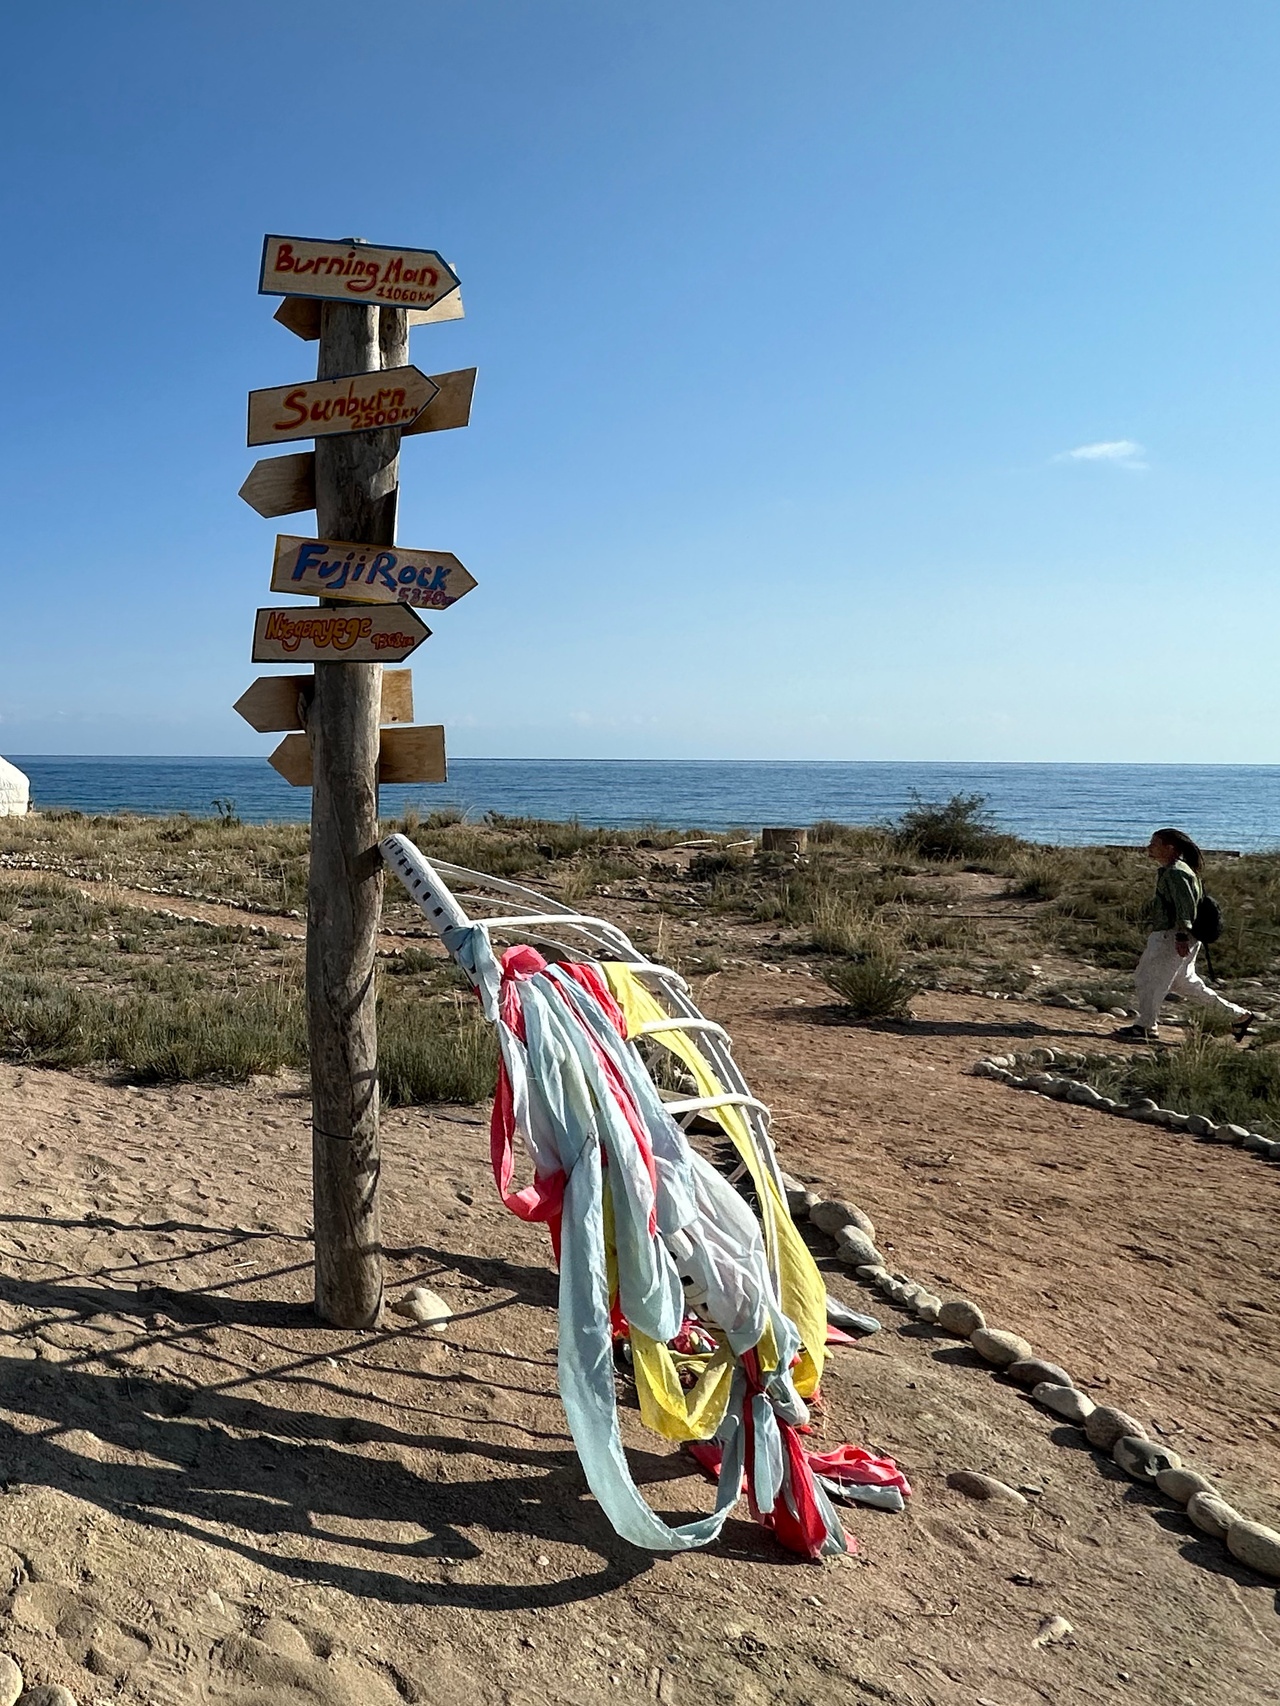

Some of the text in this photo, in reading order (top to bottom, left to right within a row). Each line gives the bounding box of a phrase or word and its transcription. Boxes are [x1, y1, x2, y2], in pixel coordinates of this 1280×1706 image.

[274, 243, 438, 292] Burning Man
[272, 380, 406, 431] Sunburn
[265, 611, 372, 651] Nyegenyege
